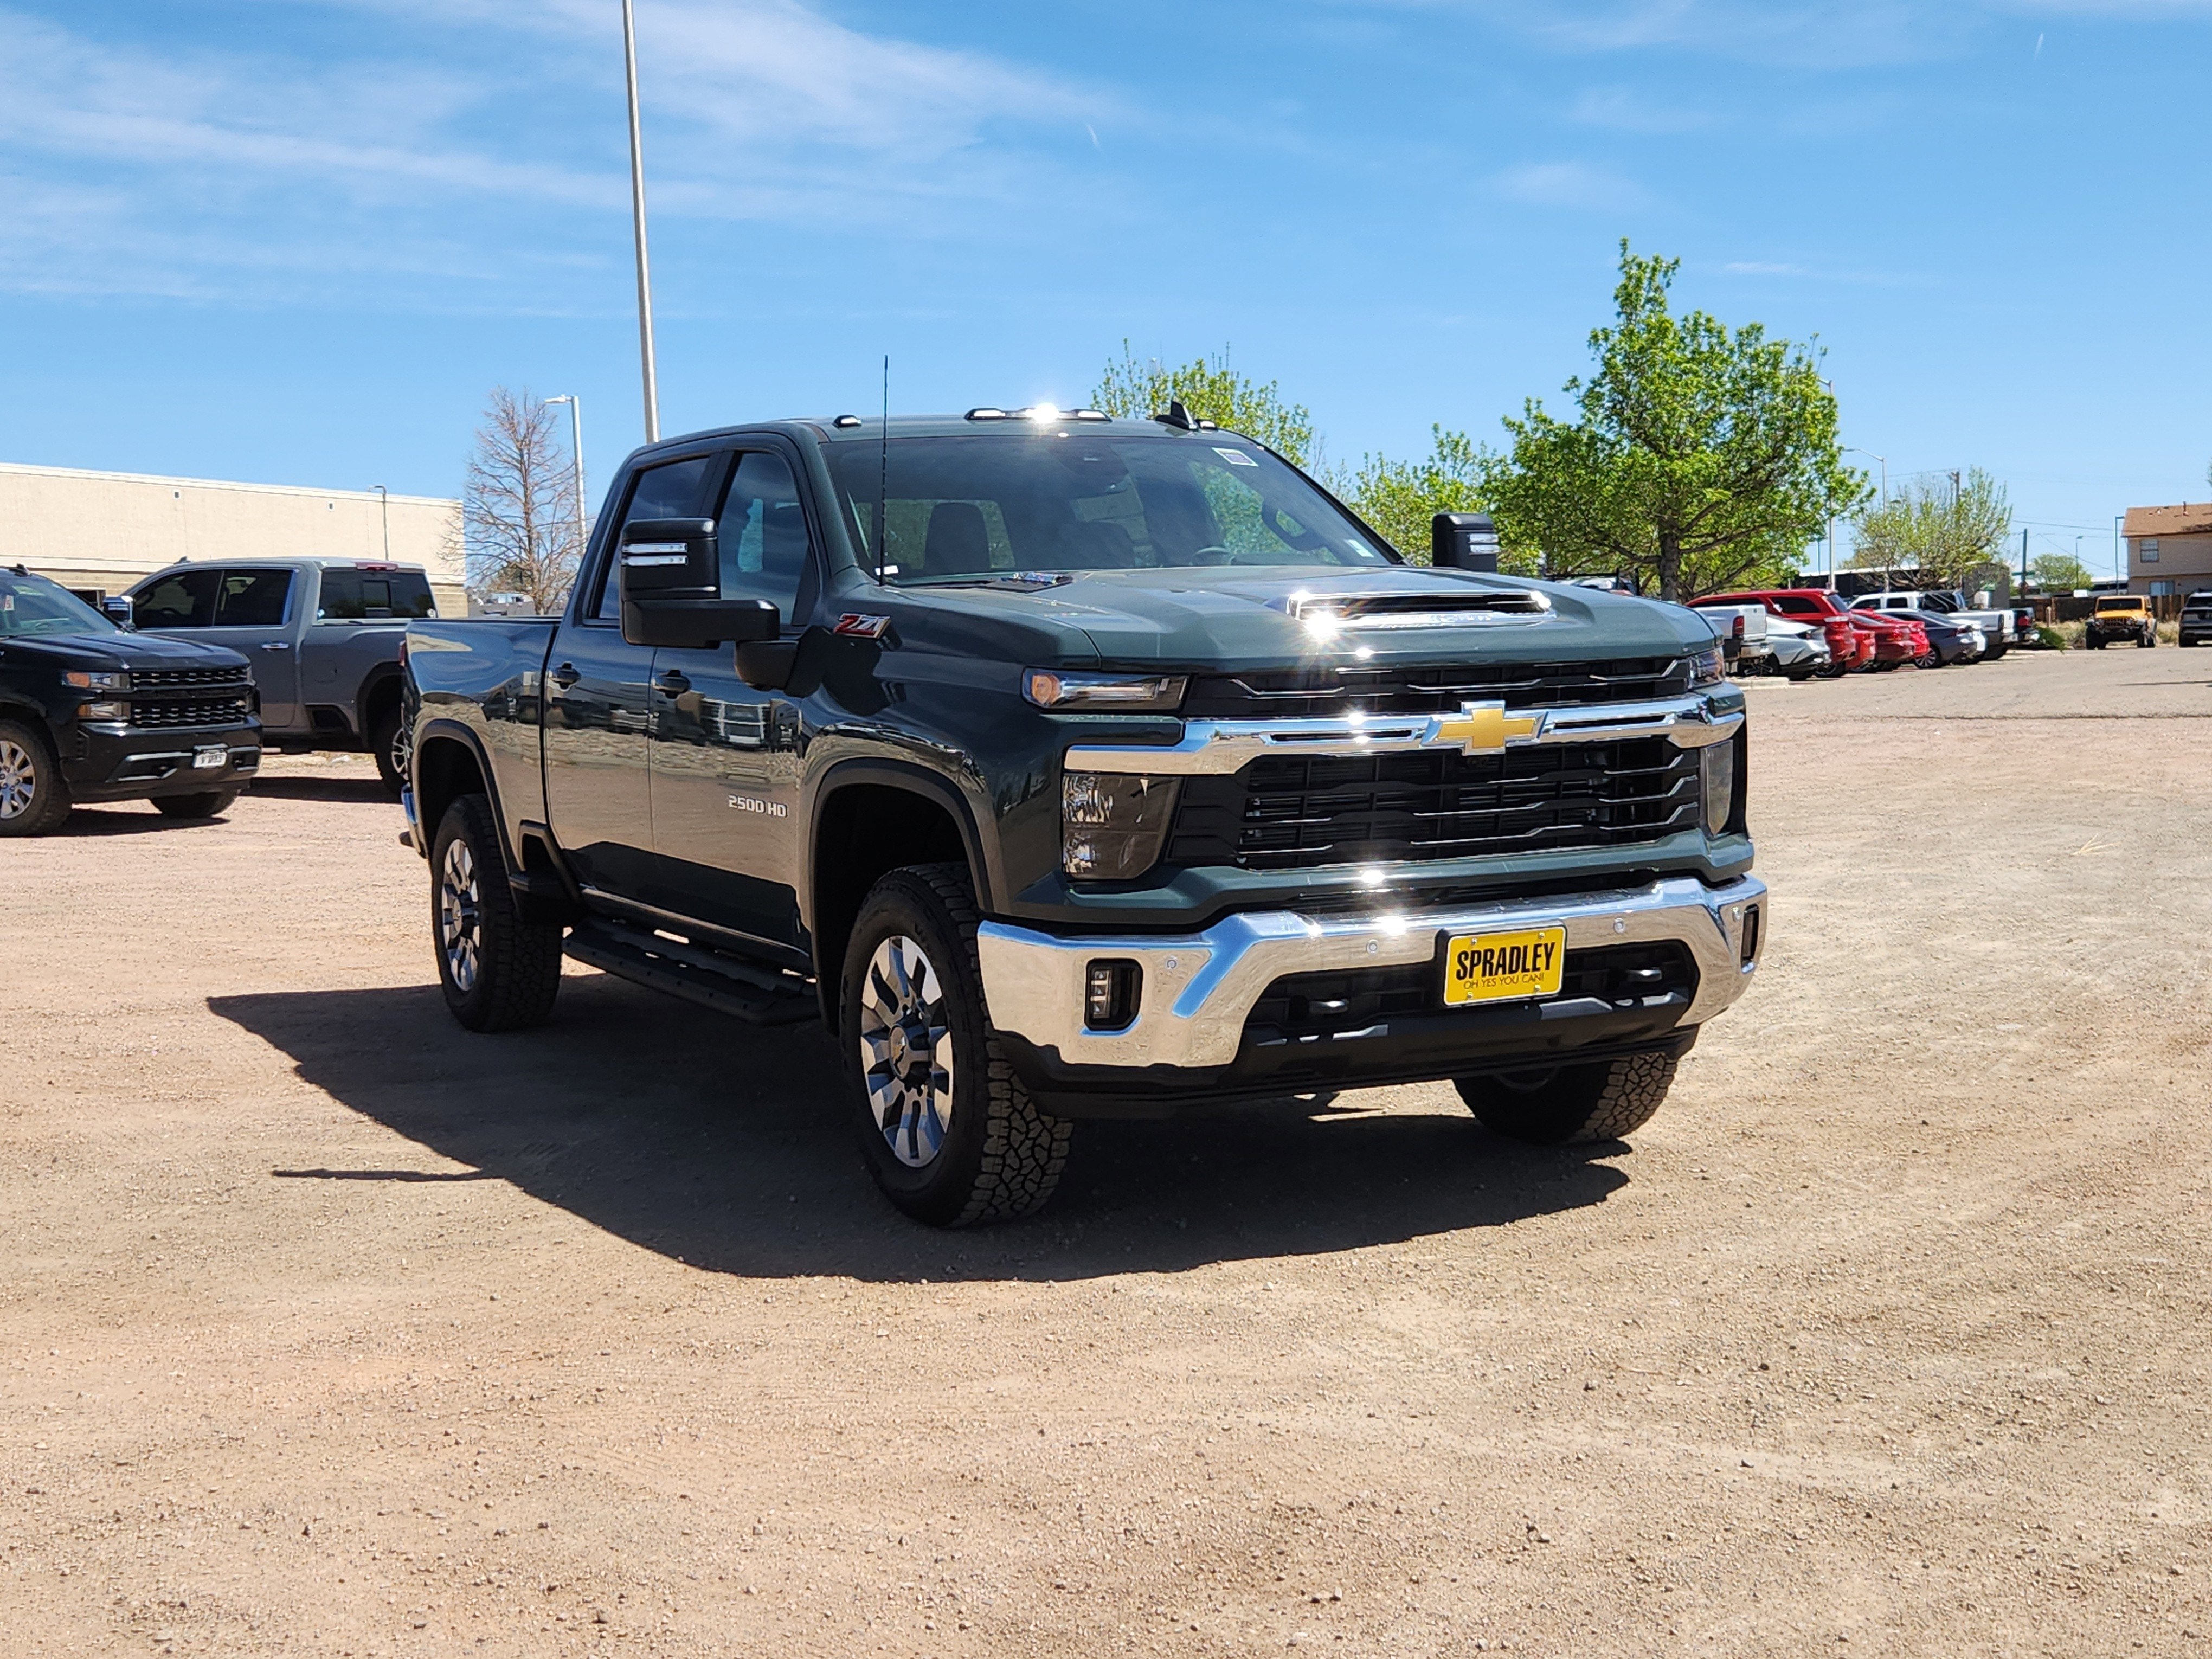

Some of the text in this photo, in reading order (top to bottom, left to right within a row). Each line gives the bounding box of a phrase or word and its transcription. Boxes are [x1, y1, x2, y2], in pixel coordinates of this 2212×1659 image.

[833, 612, 891, 639] Z71
[728, 794, 788, 818] 2500 HD
[1456, 942, 1555, 981] SPRADLEY
[1464, 979, 1478, 989] OH
[1482, 977, 1496, 987] YES
[1499, 975, 1519, 986] YOU
